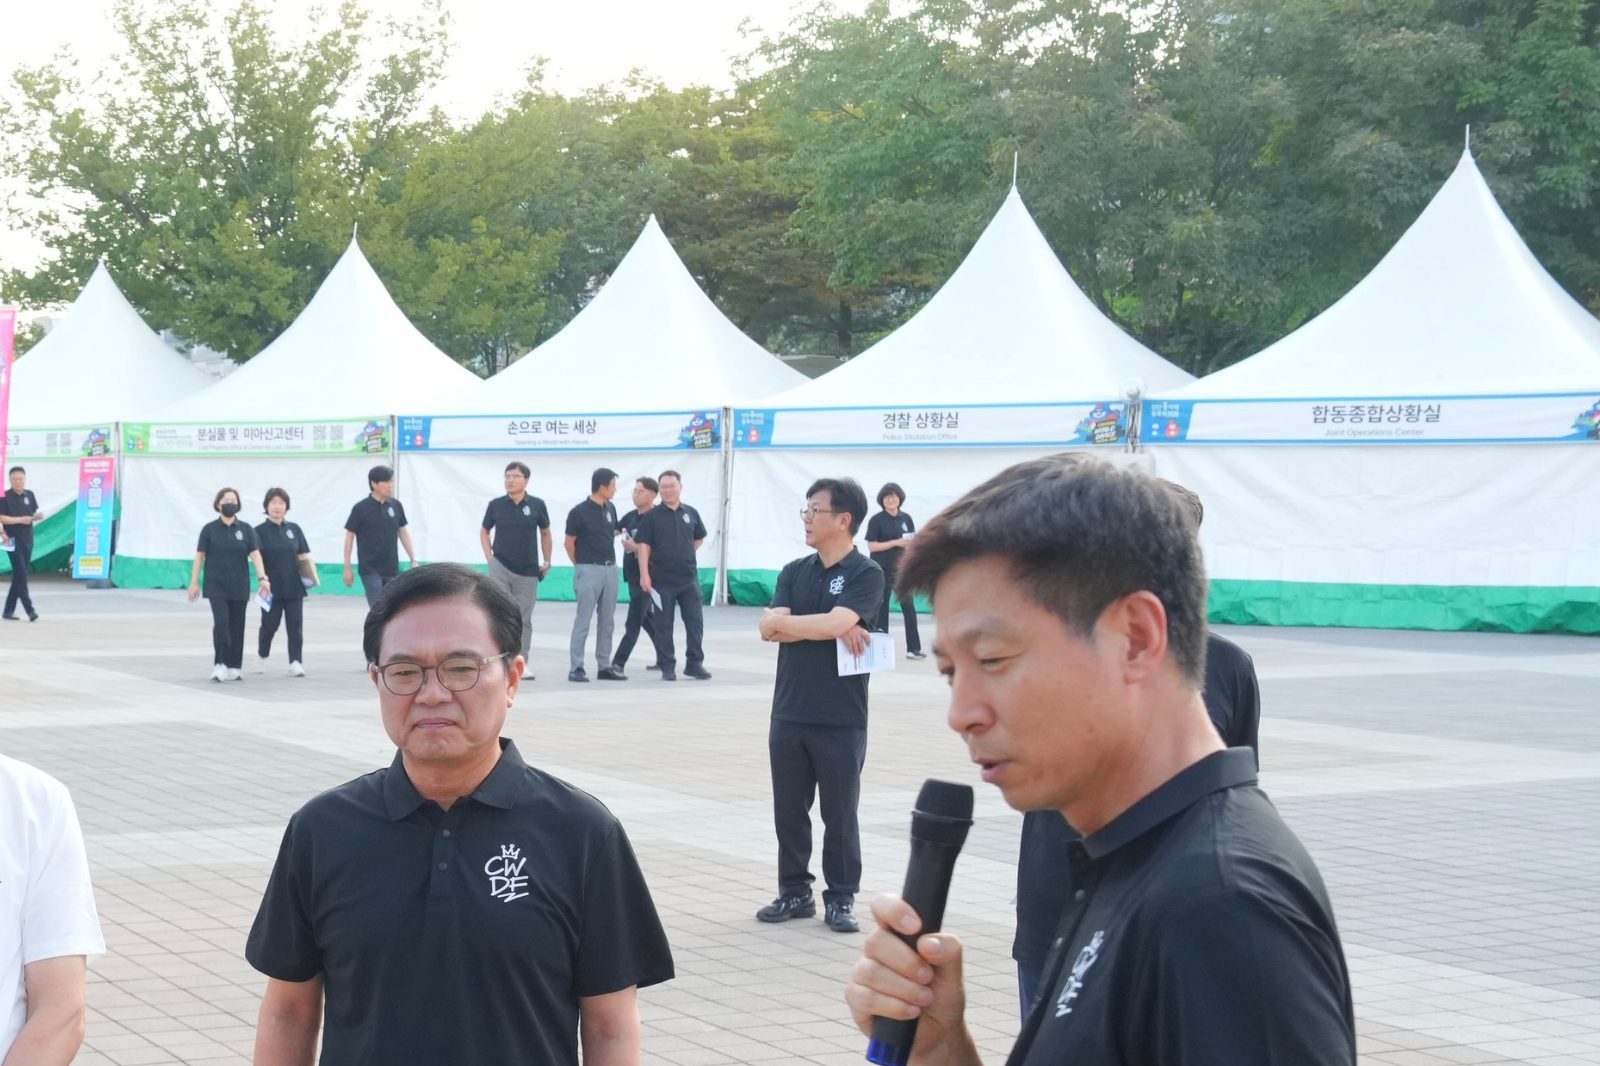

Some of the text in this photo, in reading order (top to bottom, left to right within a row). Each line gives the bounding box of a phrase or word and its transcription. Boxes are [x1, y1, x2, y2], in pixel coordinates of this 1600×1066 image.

[882, 411, 959, 429] 경찰 상황실
[1311, 404, 1441, 424] 합동종합상황실
[197, 427, 226, 442] 분실물
[228, 427, 239, 441] 및
[243, 425, 305, 441] 미아신고센터
[507, 418, 598, 436] 손으로 여는 세상
[484, 856, 527, 877] CW
[488, 876, 529, 897] DF
